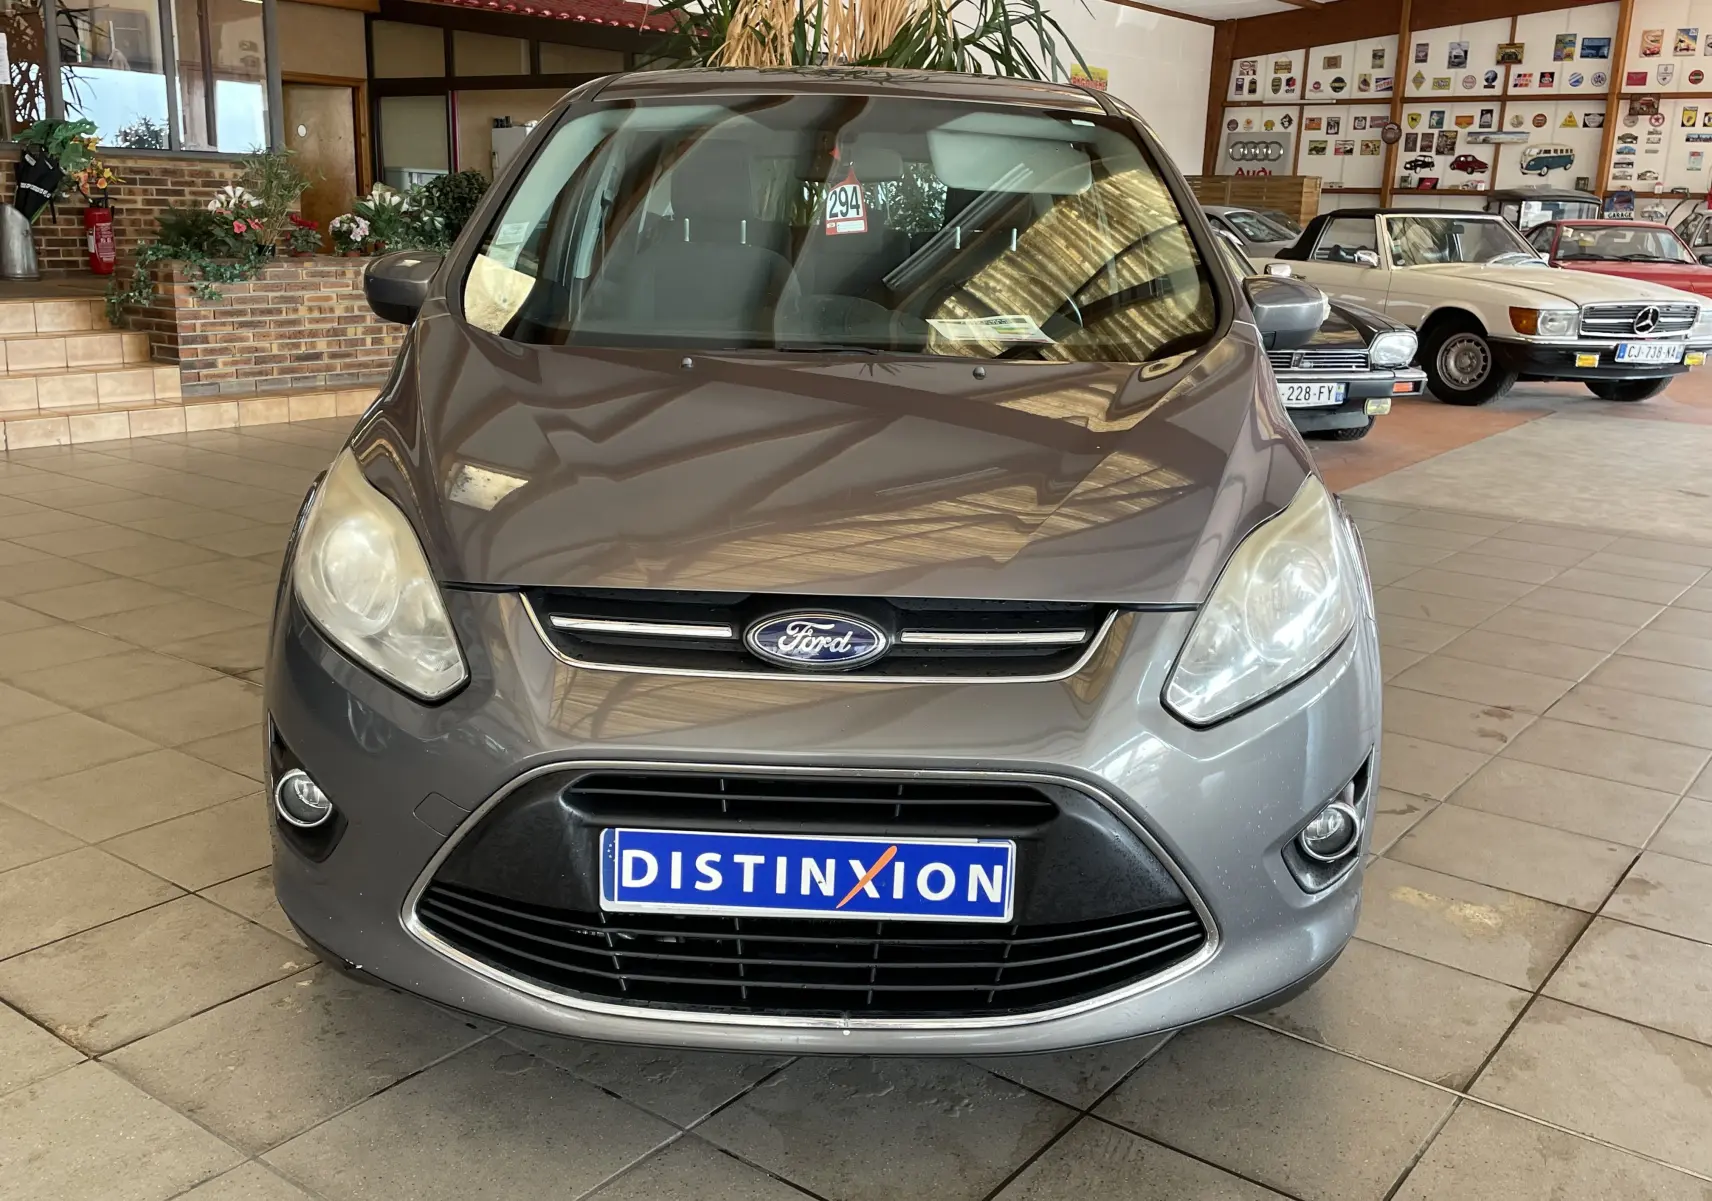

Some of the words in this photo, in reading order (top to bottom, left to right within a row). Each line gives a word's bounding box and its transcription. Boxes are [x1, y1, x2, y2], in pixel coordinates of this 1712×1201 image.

[829, 186, 861, 218] 294
[1607, 211, 1633, 219] GARAGE
[777, 621, 854, 653] Ford
[621, 846, 1004, 909] DISTINXION
